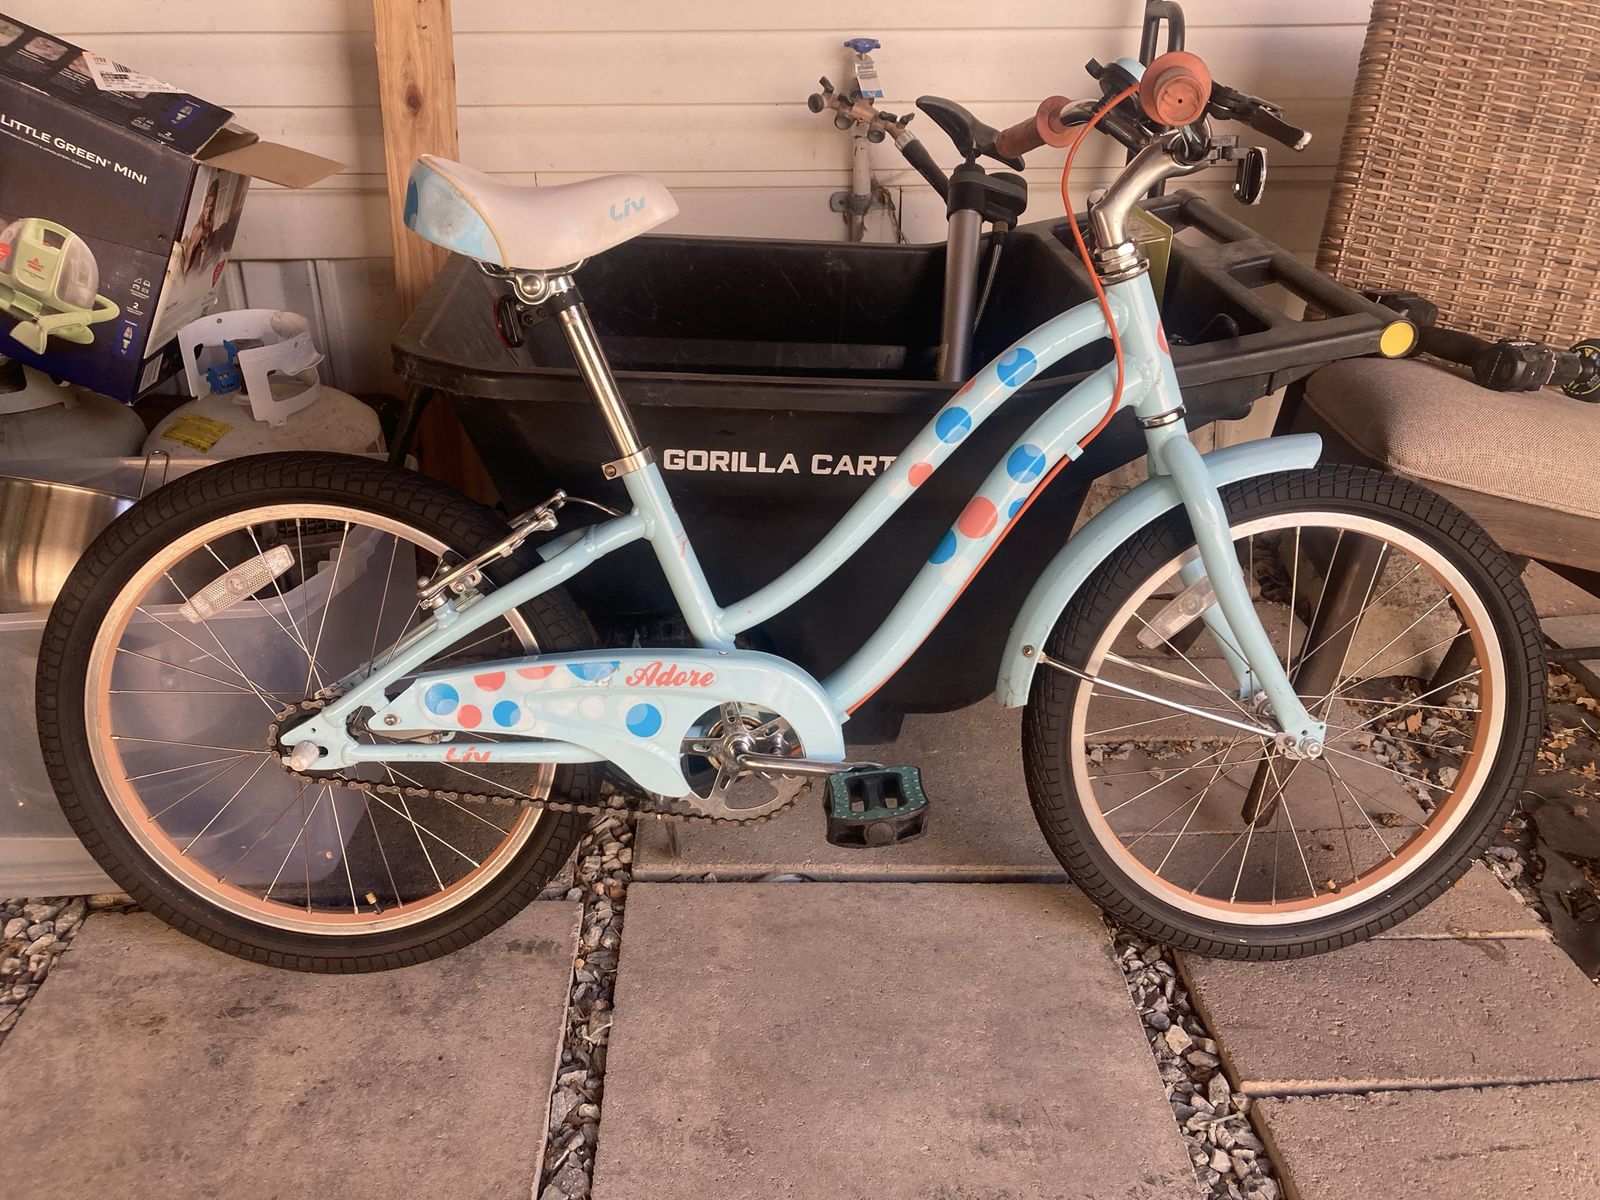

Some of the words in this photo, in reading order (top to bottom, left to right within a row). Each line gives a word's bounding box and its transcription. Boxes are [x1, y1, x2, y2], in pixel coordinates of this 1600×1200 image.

[1, 114, 52, 144] LITTLE
[114, 162, 147, 185] MINI
[610, 196, 646, 221] Liv
[663, 449, 800, 474] GORILLA
[625, 660, 714, 688] Adore
[445, 745, 492, 763] Liv
